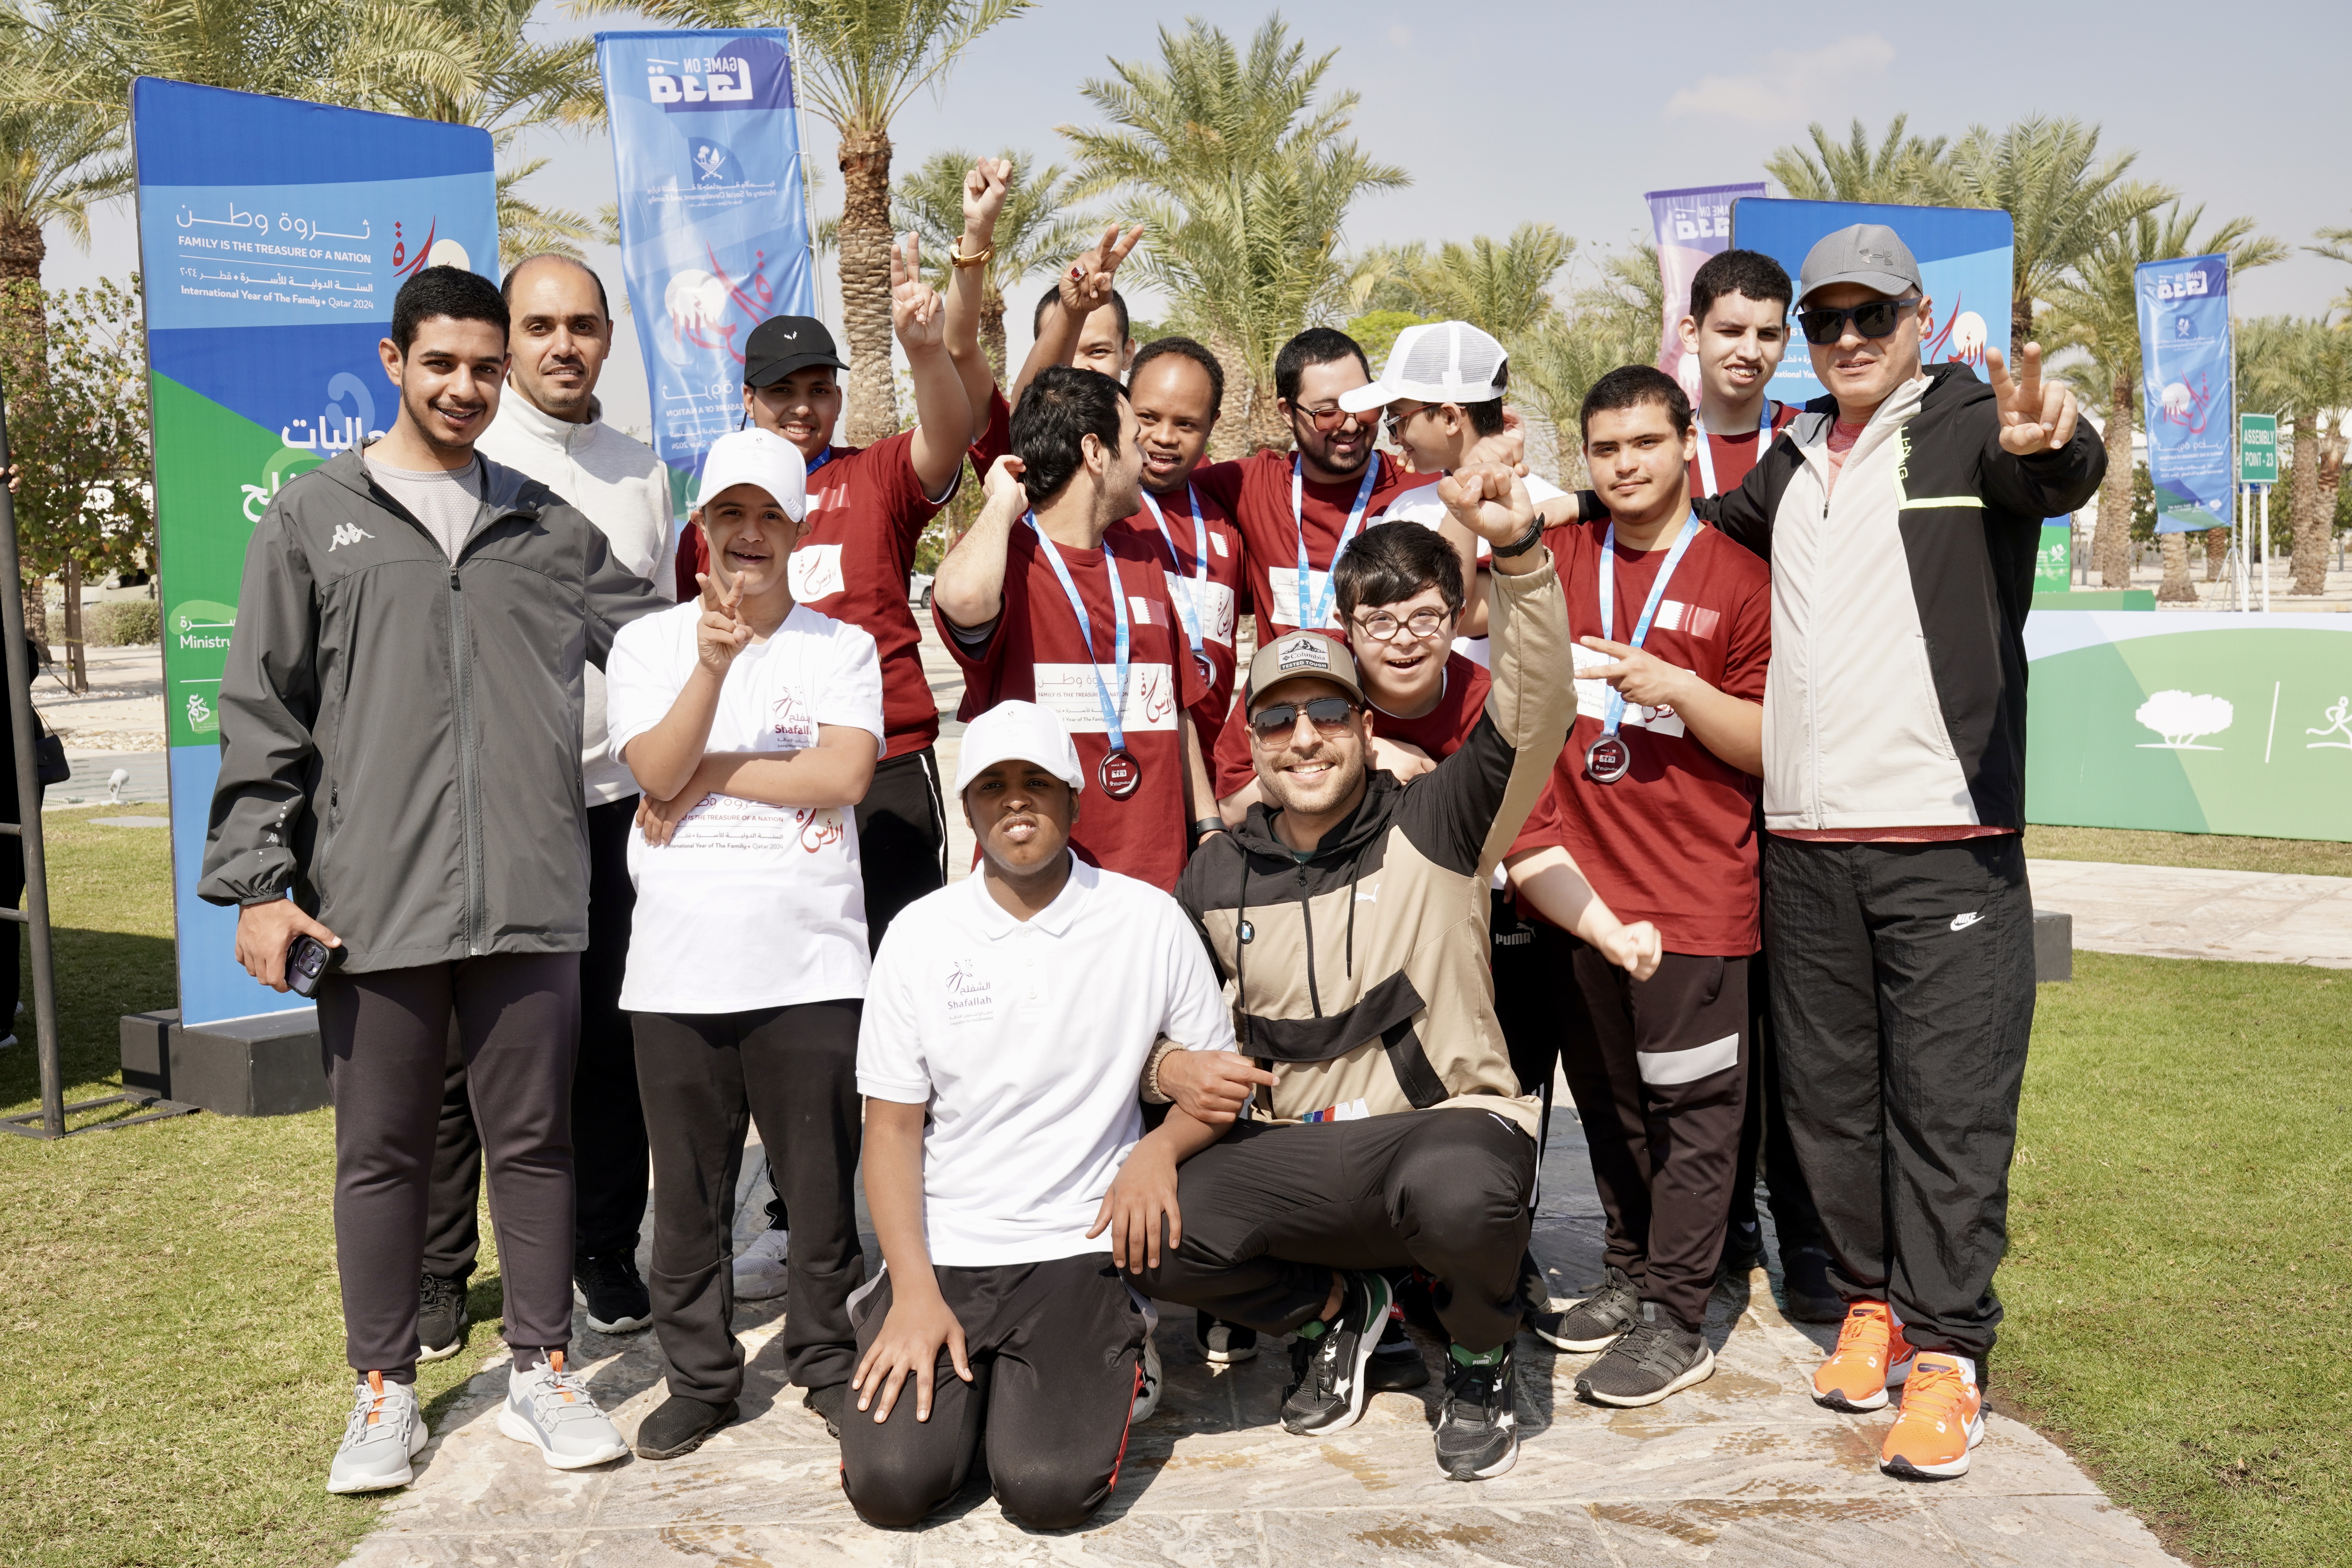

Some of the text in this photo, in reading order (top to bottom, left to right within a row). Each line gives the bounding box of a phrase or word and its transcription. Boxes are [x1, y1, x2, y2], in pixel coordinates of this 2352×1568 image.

[178, 236, 371, 263] FAMILY IS THE TREASURE OF A NATION
[181, 285, 374, 309] International Year of The Family Qatar 2024
[2243, 429, 2275, 445] ASSEMBLY
[2245, 452, 2262, 467] POINT
[2266, 452, 2274, 467] 23
[1290, 652, 1325, 661] Columbia
[1282, 661, 1304, 670] TESTED
[1588, 701, 1603, 710] Family
[1495, 932, 1531, 946] PUMA
[948, 996, 992, 1010] Shafallah
